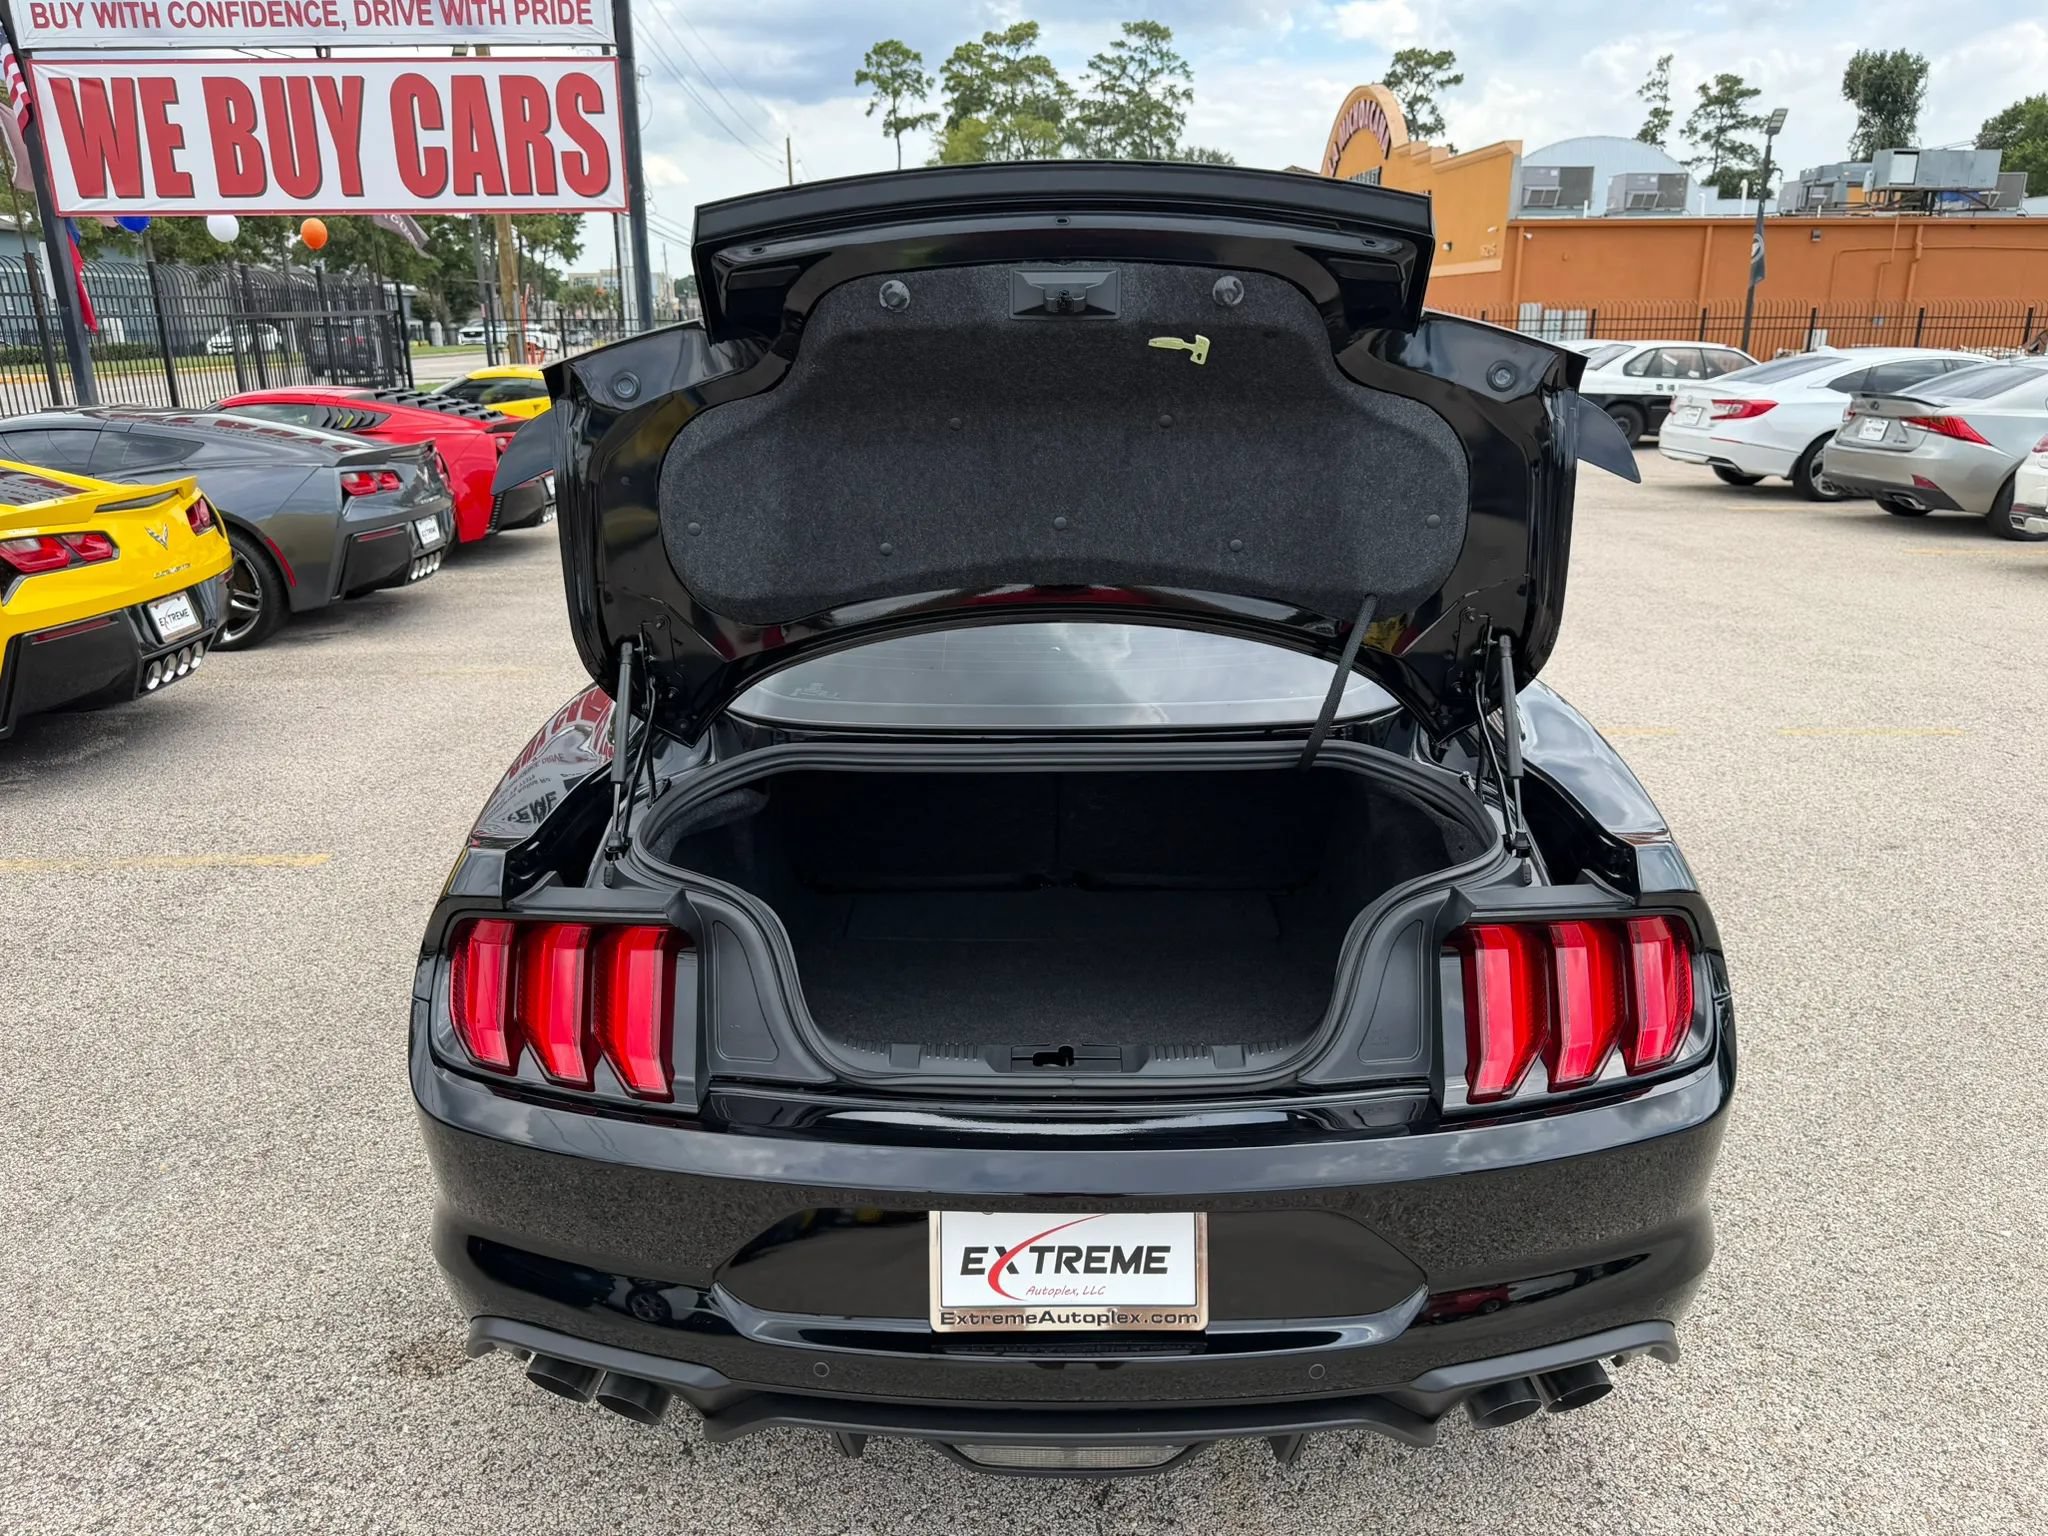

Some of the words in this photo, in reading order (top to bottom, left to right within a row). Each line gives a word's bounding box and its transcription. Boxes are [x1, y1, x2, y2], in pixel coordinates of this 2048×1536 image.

[30, 2, 84, 29] BUY
[91, 1, 161, 29] WITH
[168, 0, 347, 31] CONFIDENCE,
[354, 0, 434, 26] DRIVE
[439, 0, 506, 26] WITH
[515, 0, 593, 25] PRIDE
[48, 77, 196, 199] WE
[202, 75, 365, 199] BUY
[389, 72, 612, 198] CARS
[158, 608, 190, 627] EXTREME
[960, 1245, 1172, 1276] EXTREME
[1025, 1285, 1079, 1297] Autoplex,
[1082, 1285, 1107, 1296] LLC
[940, 1310, 1199, 1327] ExtremeAutoplex.com
